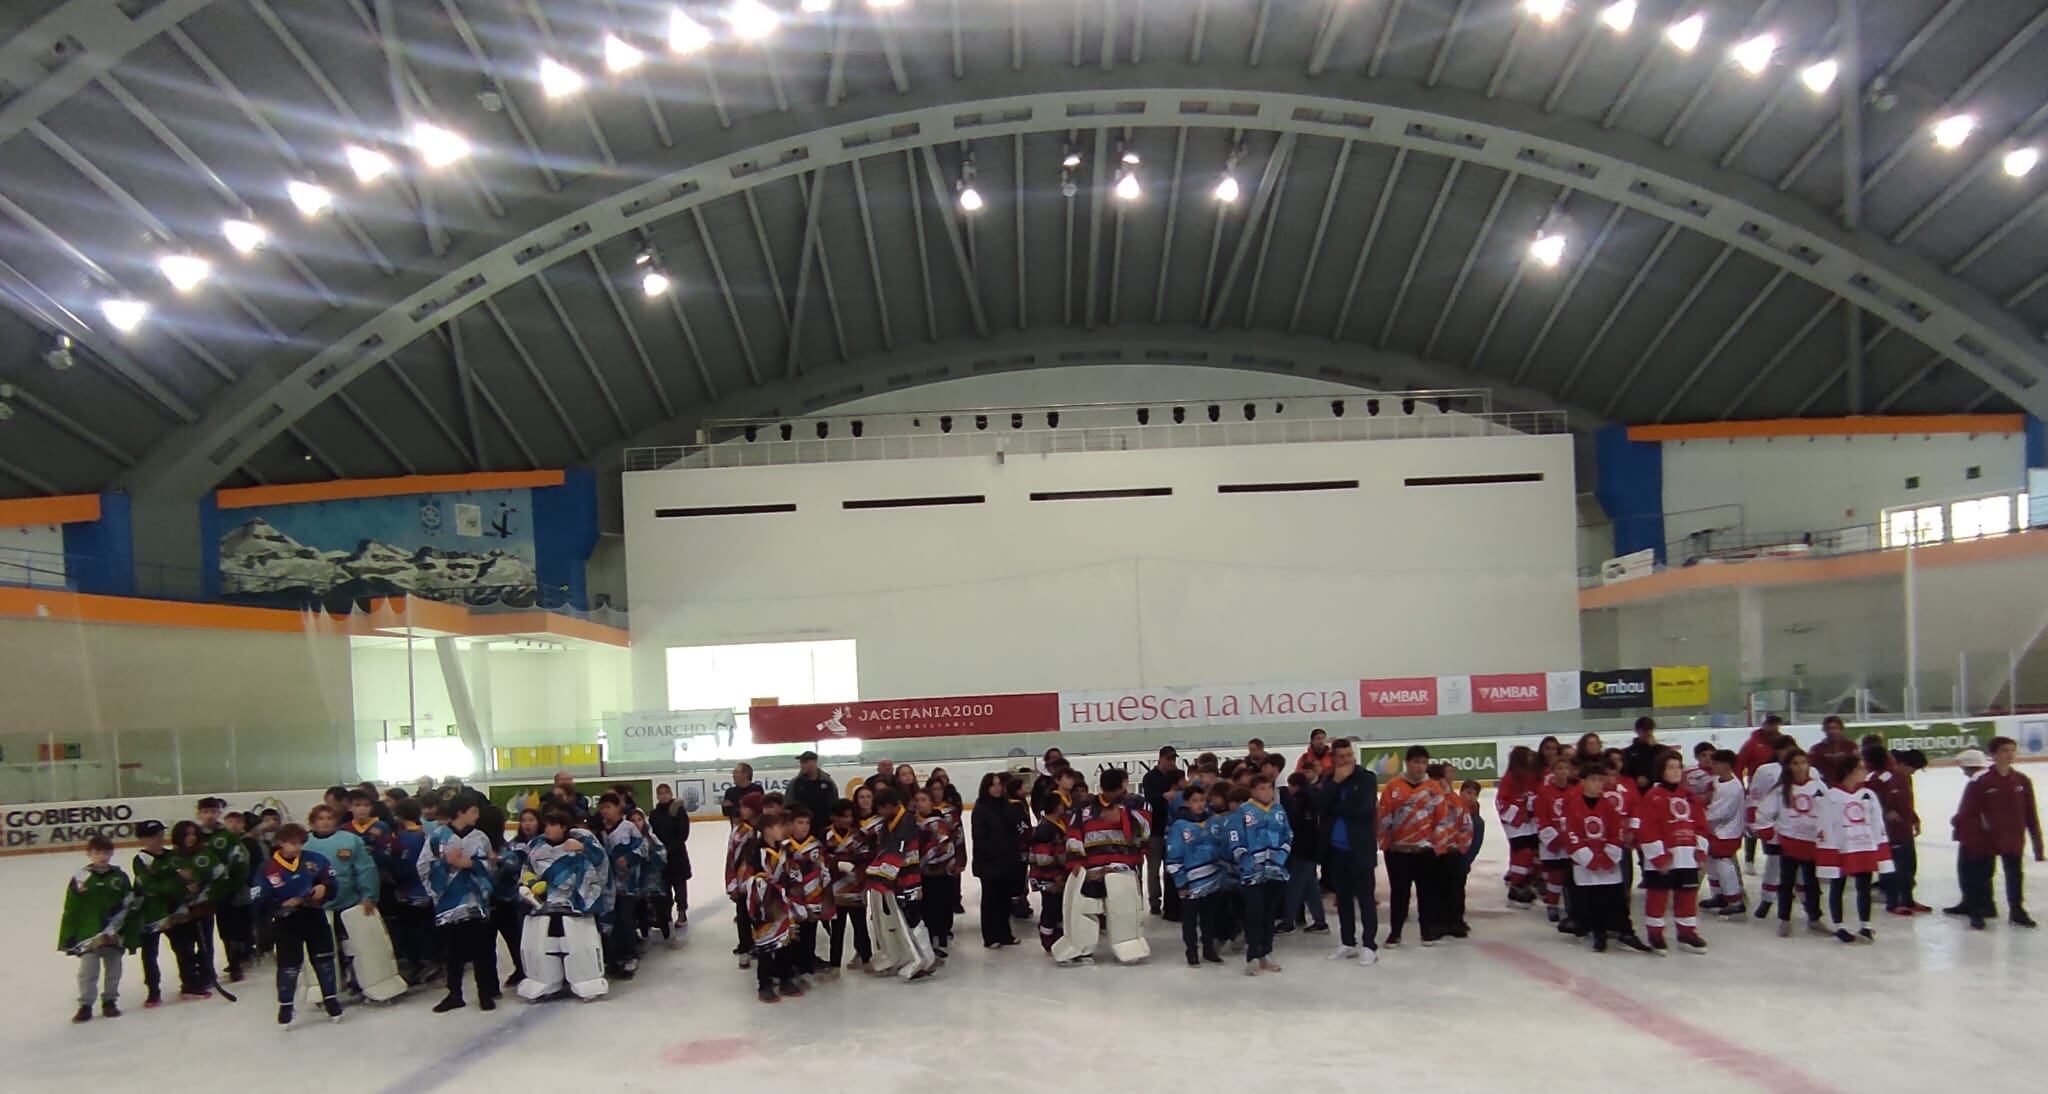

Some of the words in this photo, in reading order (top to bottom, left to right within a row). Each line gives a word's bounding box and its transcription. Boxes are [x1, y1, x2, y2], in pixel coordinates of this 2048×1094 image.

[1489, 685, 1538, 699] AMBAR
[1586, 679, 1645, 696] embou
[1379, 690, 1430, 703] AMBAR
[858, 704, 994, 721] JACETANIA2000
[624, 723, 706, 738] COBARCHO
[1887, 735, 1979, 751] IBERDROLA
[5, 804, 132, 828] GOBIERNO
[1568, 831, 1579, 844] 5
